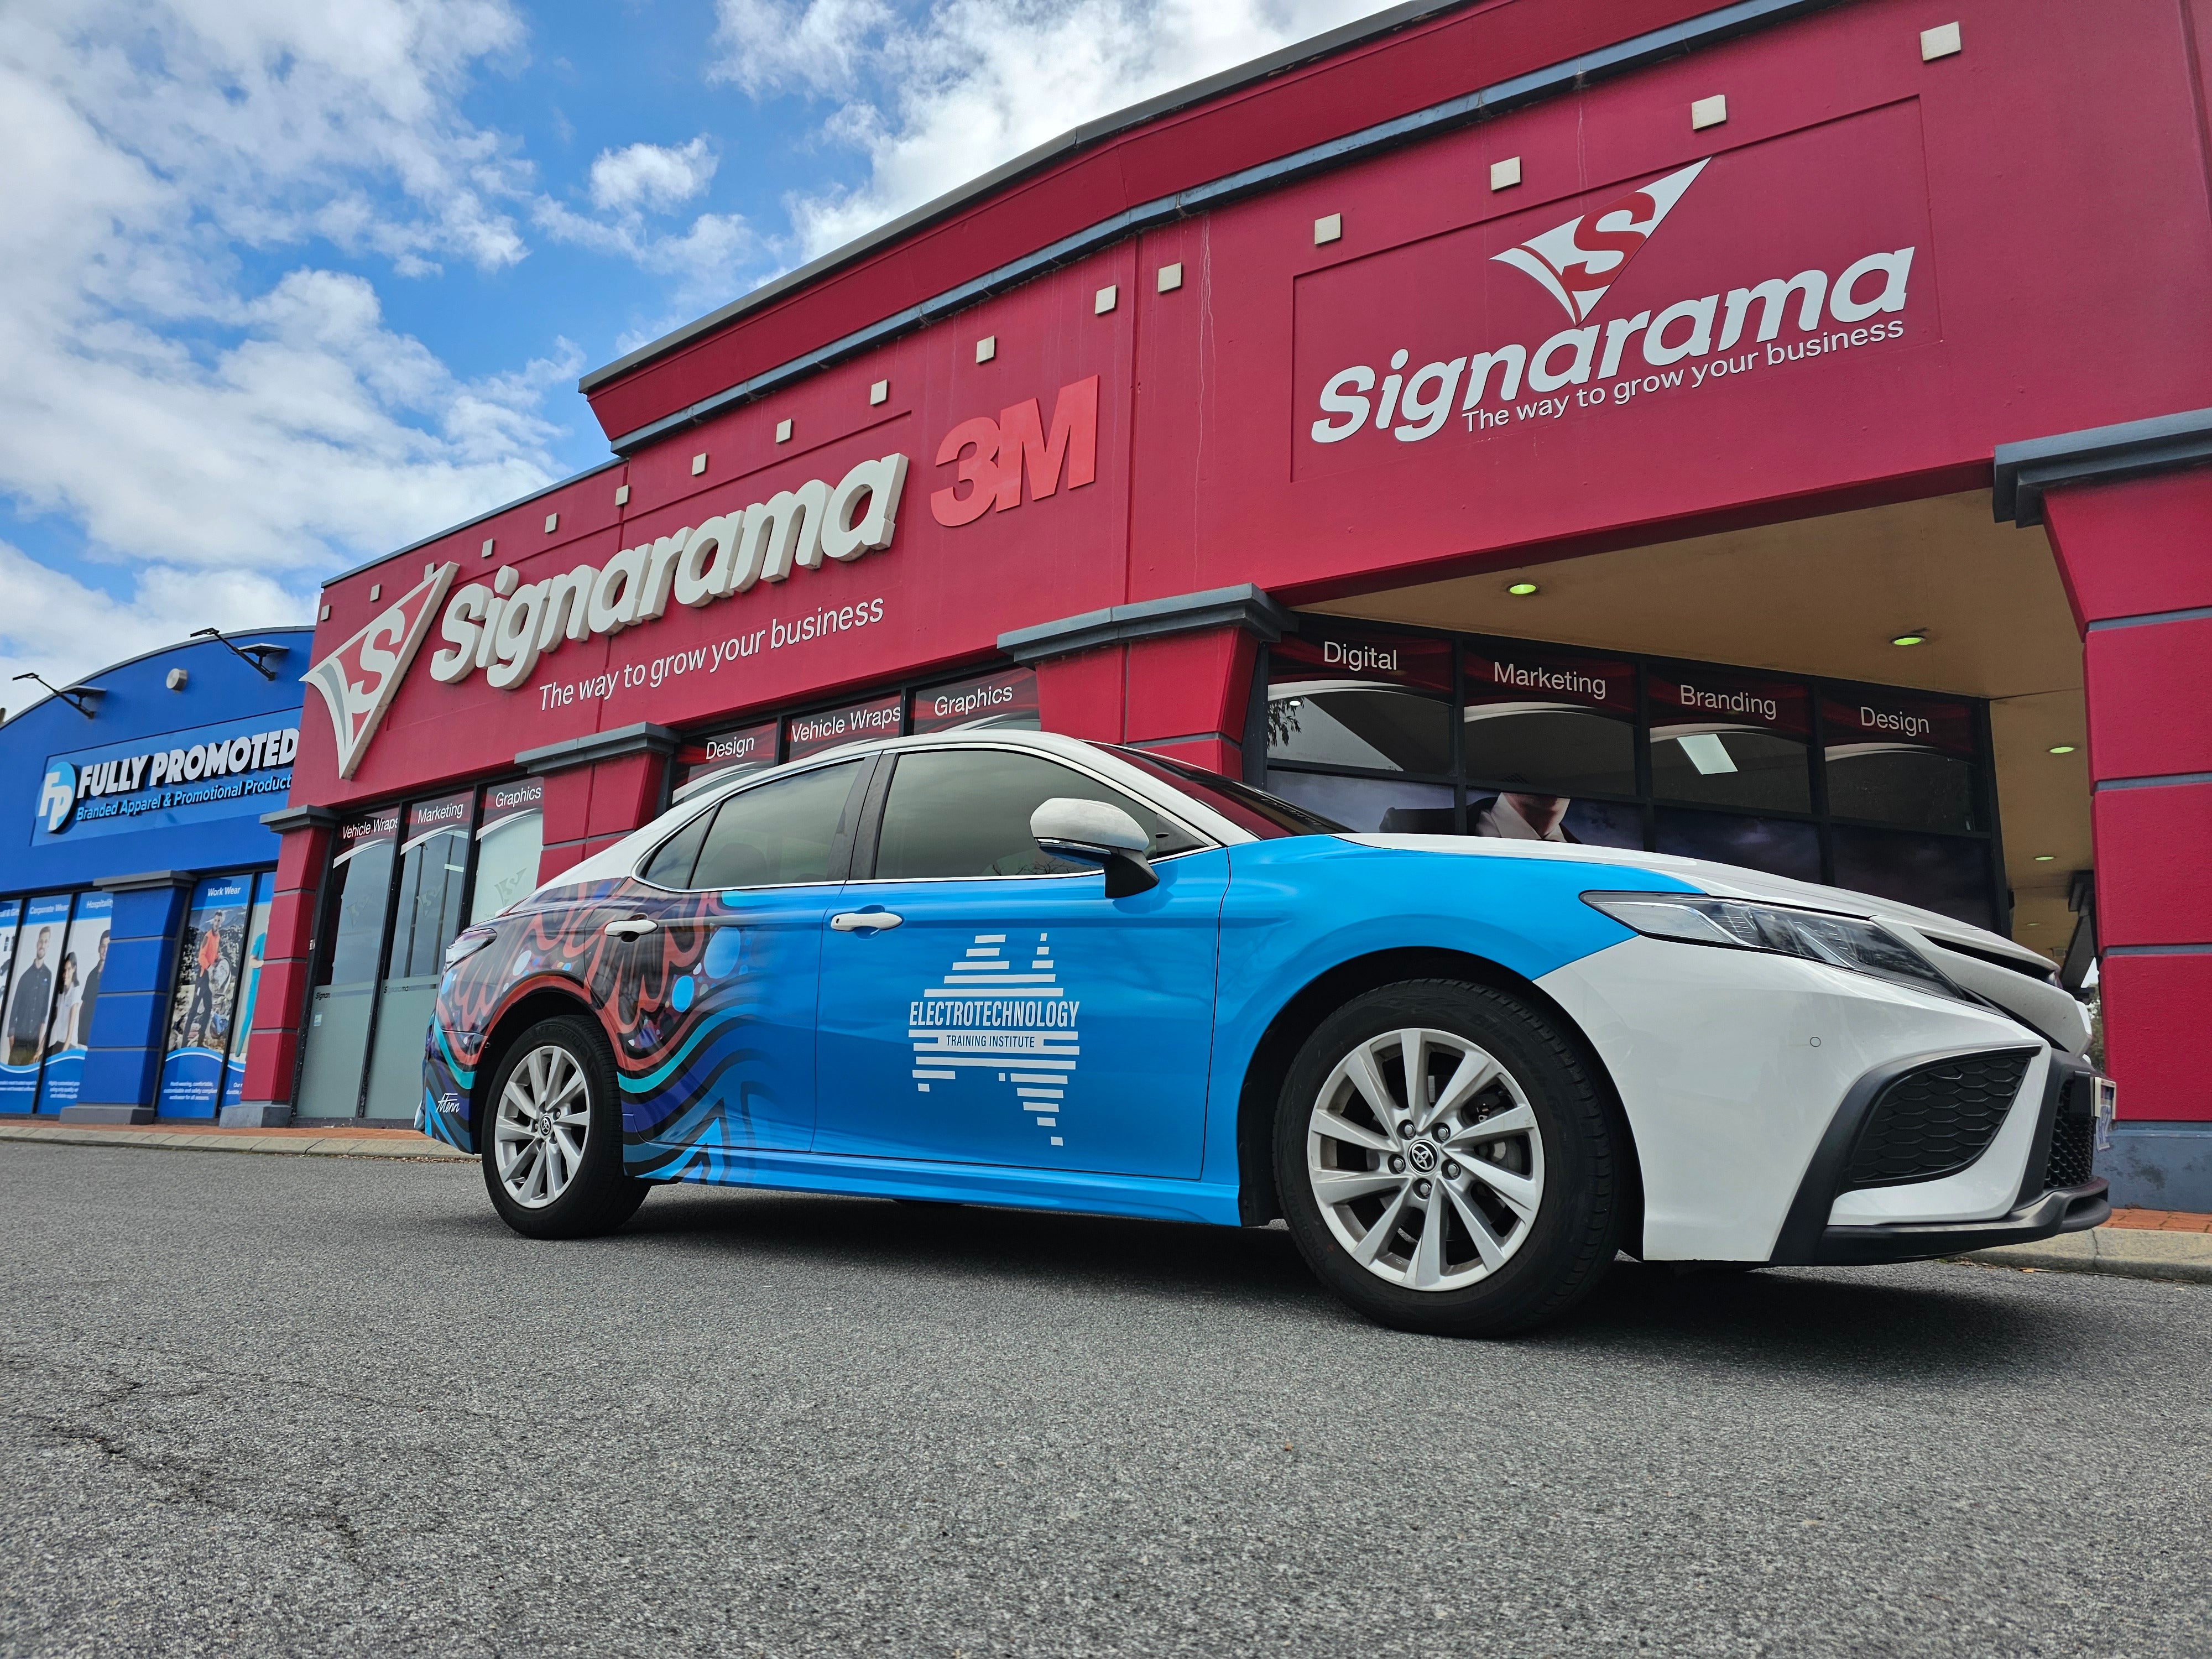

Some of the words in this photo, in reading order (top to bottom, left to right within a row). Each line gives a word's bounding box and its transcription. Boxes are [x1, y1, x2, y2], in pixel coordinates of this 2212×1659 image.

[1311, 247, 1914, 442] Signarama
[1462, 408, 1510, 432] The
[1516, 395, 1570, 419] way
[1576, 387, 1606, 407] to
[1613, 369, 1684, 405] grow
[1691, 352, 1759, 388] your
[1767, 319, 1903, 366] business
[930, 374, 1098, 528] 3M
[430, 453, 909, 690] Signarama
[539, 682, 574, 711] The
[579, 671, 619, 701] way
[623, 664, 645, 688] to
[650, 646, 707, 688] grow
[709, 629, 766, 674] your
[770, 598, 884, 649] business
[1323, 641, 1397, 671] Digital
[1494, 661, 1606, 700] Marketing
[934, 686, 1013, 717] Graphics
[1680, 684, 1777, 720] Branding
[791, 717, 845, 743] Vehicle
[849, 706, 901, 732] Wraps
[1860, 706, 1929, 737] Design
[76, 754, 150, 799] FULLY
[149, 727, 300, 786] PROMOTED
[706, 735, 754, 760] Design
[76, 800, 118, 821] Branded
[119, 794, 161, 816] Apparel
[163, 792, 171, 807] &
[174, 780, 243, 805] Promotional
[417, 803, 463, 824] Marketing
[495, 786, 541, 808] Graphics
[342, 822, 371, 840] Vehicle
[207, 887, 224, 896] Work
[225, 886, 241, 895] Wear
[909, 1000, 1080, 1027] ELECTROTECHNOLOGY
[946, 1035, 987, 1047] TRAINING
[989, 1035, 1035, 1048] INSTITUTE
